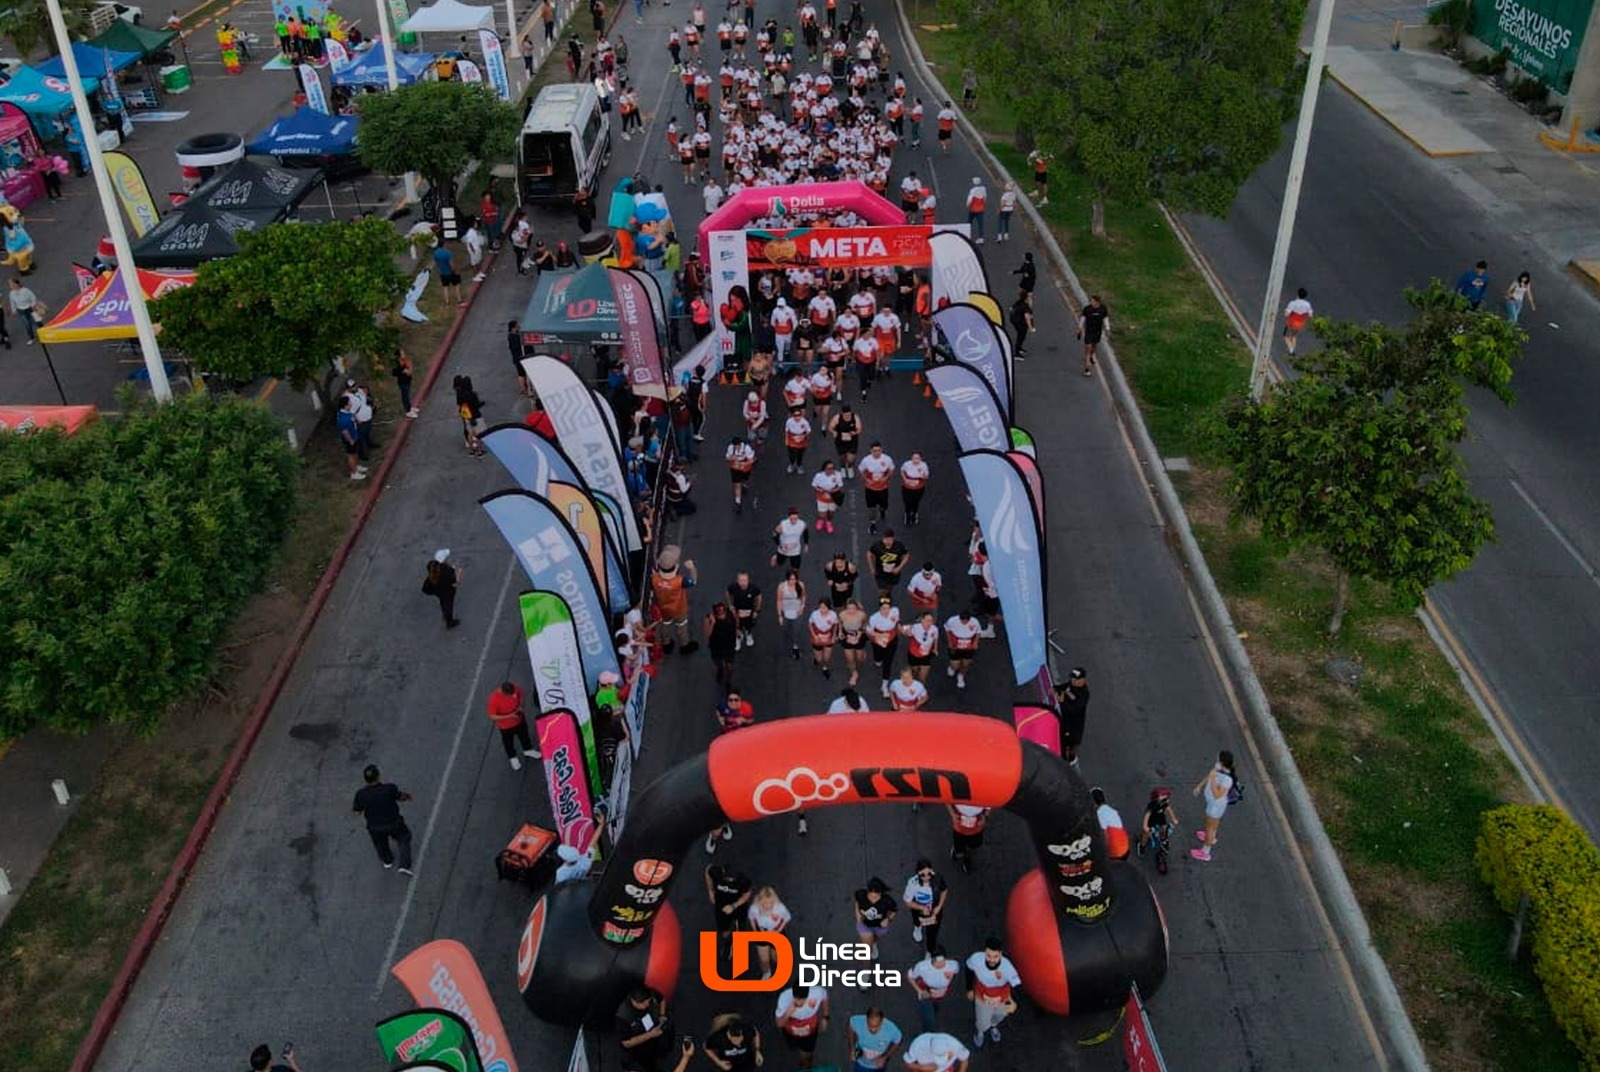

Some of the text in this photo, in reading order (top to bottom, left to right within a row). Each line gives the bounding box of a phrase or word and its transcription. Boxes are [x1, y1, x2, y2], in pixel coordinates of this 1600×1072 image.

[1495, 0, 1572, 49] DESAYUNOS
[1498, 14, 1558, 60] REGIONALES
[810, 236, 888, 259] META
